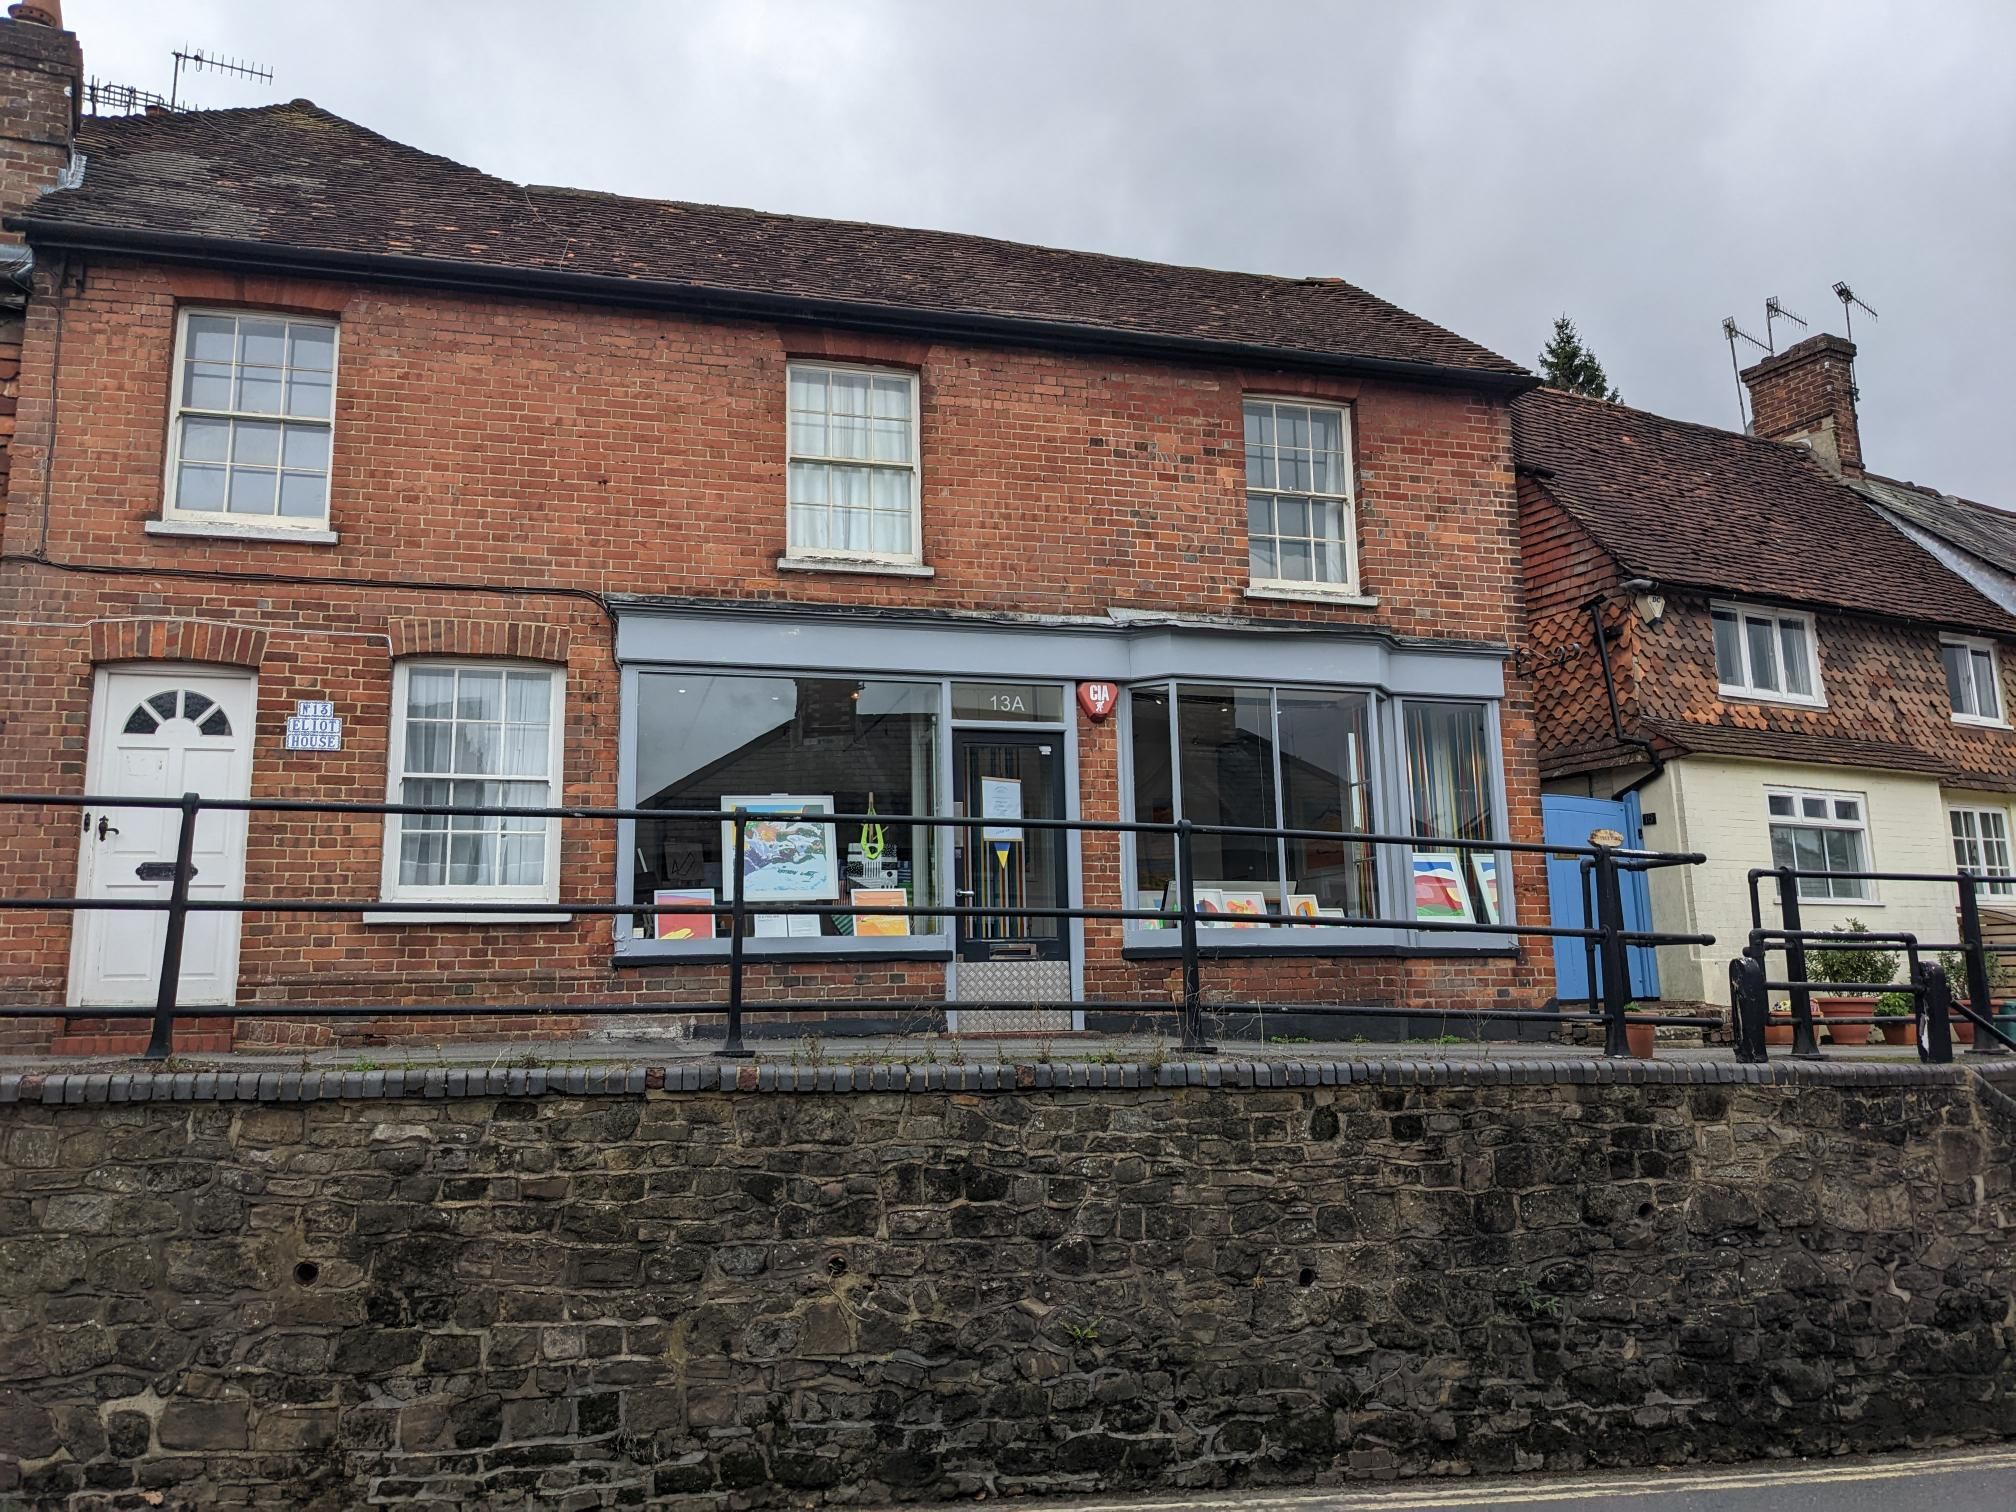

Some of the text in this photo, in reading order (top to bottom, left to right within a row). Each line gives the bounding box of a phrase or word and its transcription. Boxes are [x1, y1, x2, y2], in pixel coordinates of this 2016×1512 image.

[1090, 685, 1109, 701] CIA
[990, 695, 1025, 711] 13A
[292, 720, 337, 732] ELIOT
[291, 736, 336, 748] HOUSE
